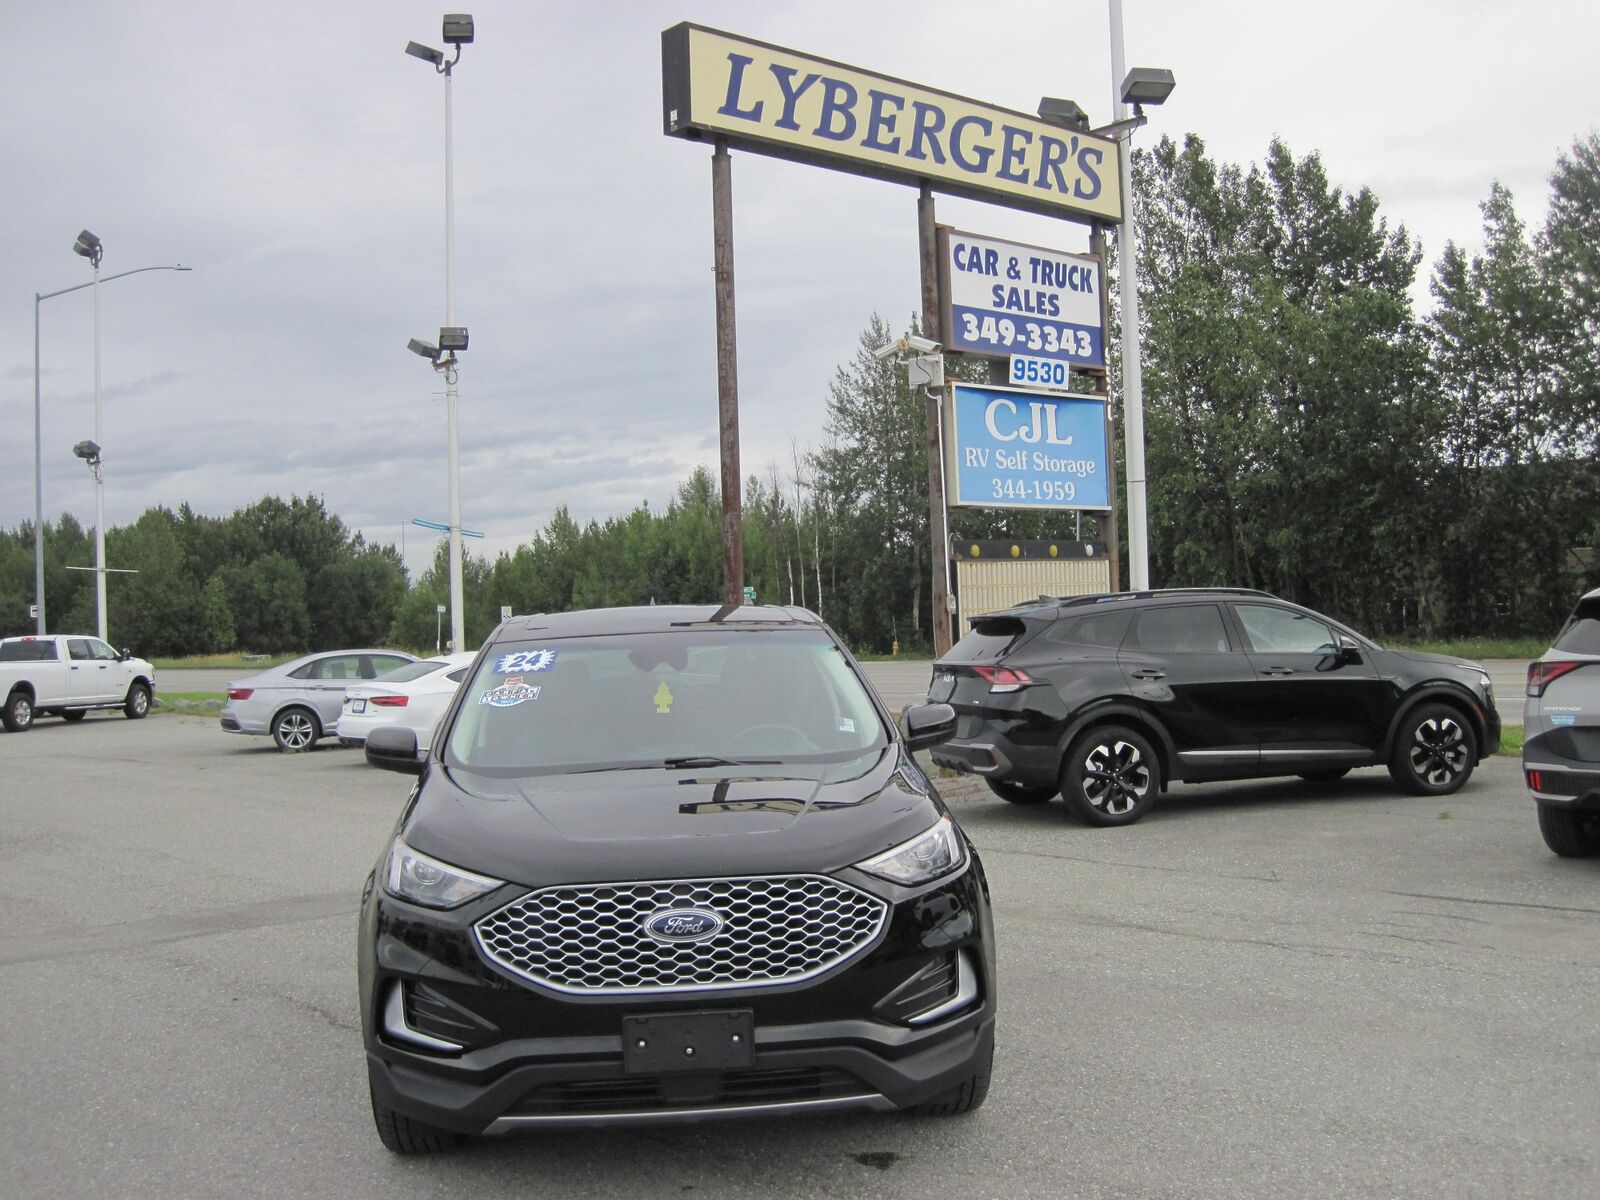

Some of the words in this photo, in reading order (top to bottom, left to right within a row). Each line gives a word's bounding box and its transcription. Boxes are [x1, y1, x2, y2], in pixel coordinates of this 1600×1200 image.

[717, 52, 1104, 201] LYBERGER'S
[953, 243, 999, 276] CAR
[1006, 256, 1021, 280] &
[1029, 257, 1093, 293] TRUCK
[992, 284, 1060, 317] SALES
[962, 313, 1092, 357] 349-3343
[1013, 358, 1065, 385] 9530
[985, 399, 1073, 445] CJL
[965, 447, 989, 468] RV
[995, 450, 1028, 470] Self
[1032, 452, 1095, 477] Storage
[992, 478, 1076, 501] 344-1959
[508, 653, 542, 668] 24
[664, 916, 704, 934] Ford
